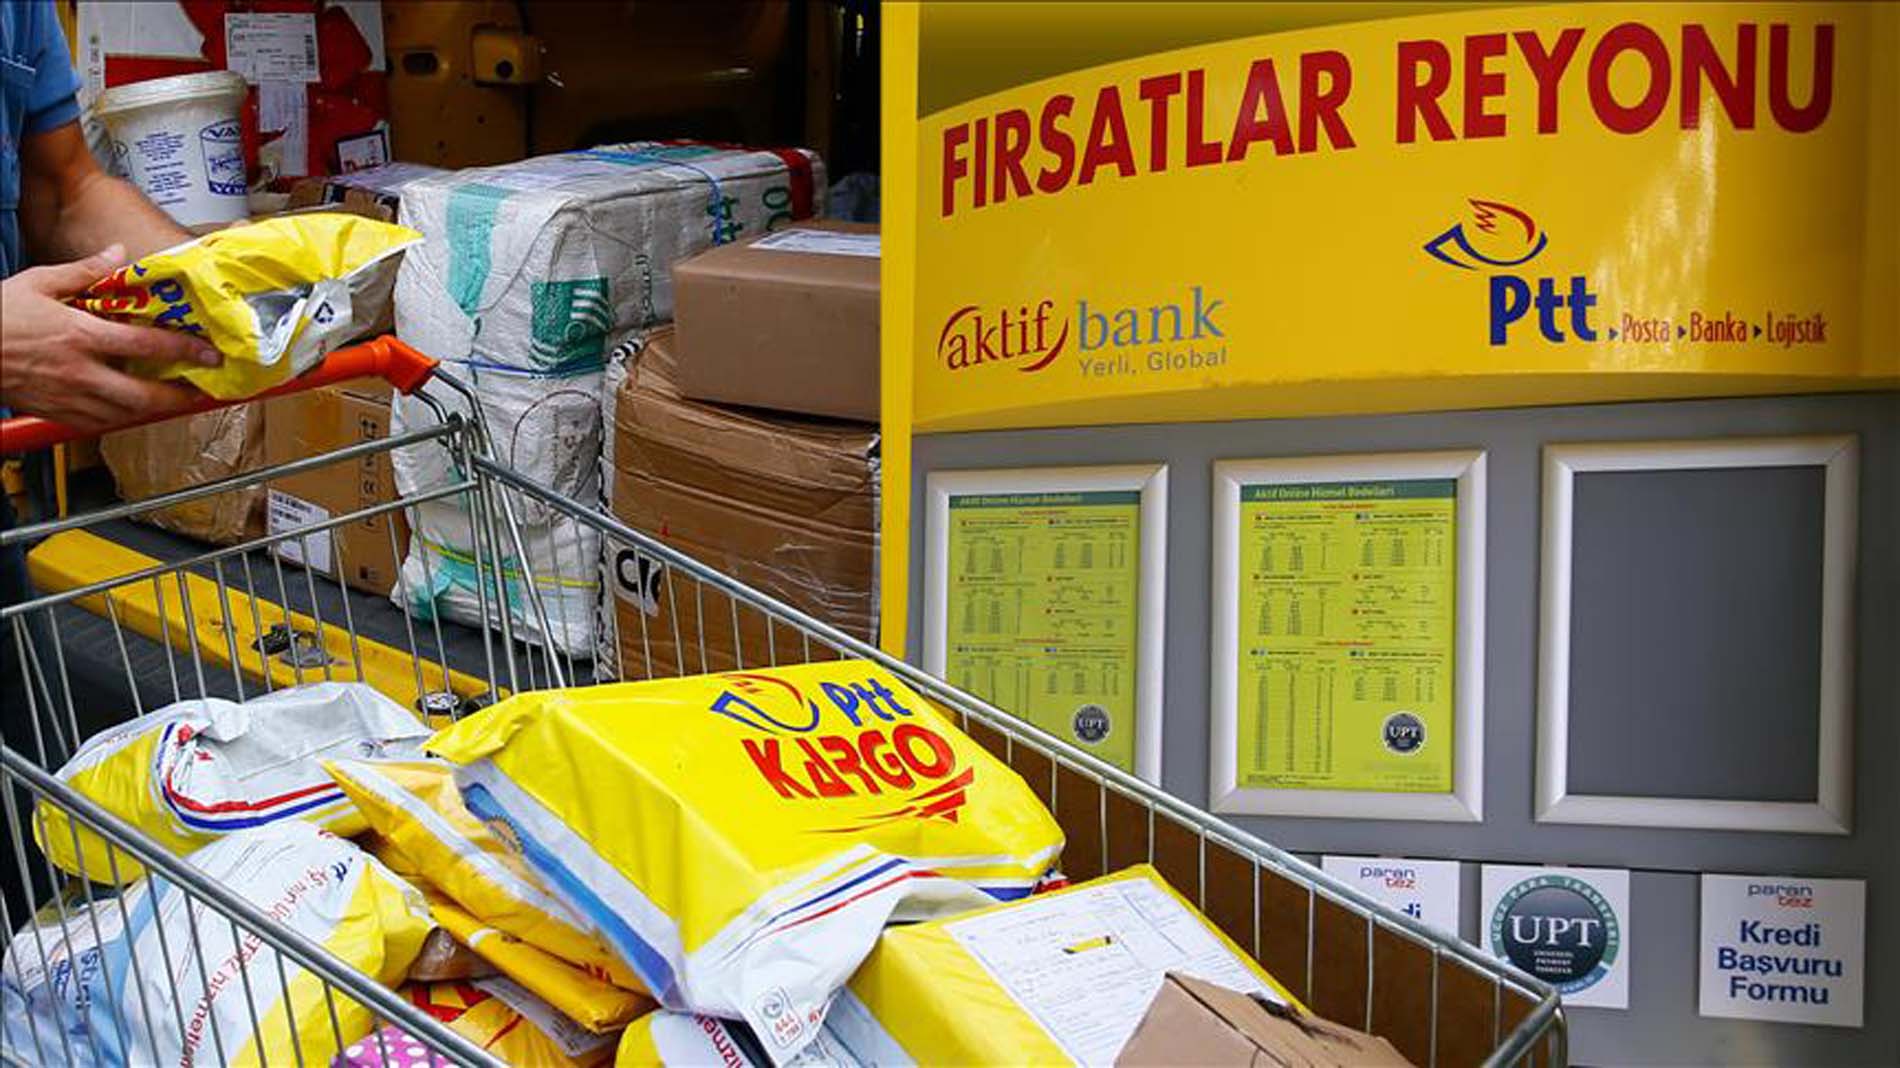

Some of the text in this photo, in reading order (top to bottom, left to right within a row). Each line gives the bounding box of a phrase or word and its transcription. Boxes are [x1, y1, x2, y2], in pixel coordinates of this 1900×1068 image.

[940, 21, 1836, 217] FIRSATLAR REYONU
[1489, 275, 1597, 346] Ptt
[947, 286, 1225, 370] aktif bank
[1621, 310, 1827, 349] Posta Banka Lojistik
[1147, 346, 1227, 372] Global
[819, 678, 914, 727] Ptt
[1077, 716, 1103, 729] UPT
[1389, 725, 1418, 739] UPT
[741, 723, 956, 800] KARGO
[1360, 865, 1415, 879] paran
[1385, 878, 1415, 889] tez
[1747, 883, 1814, 897] paran
[1777, 895, 1815, 908] tez
[1509, 914, 1600, 947] UPT
[1740, 919, 1821, 947] Kredi
[1717, 946, 1844, 977] Başvuru
[1729, 975, 1830, 1005] Formu
